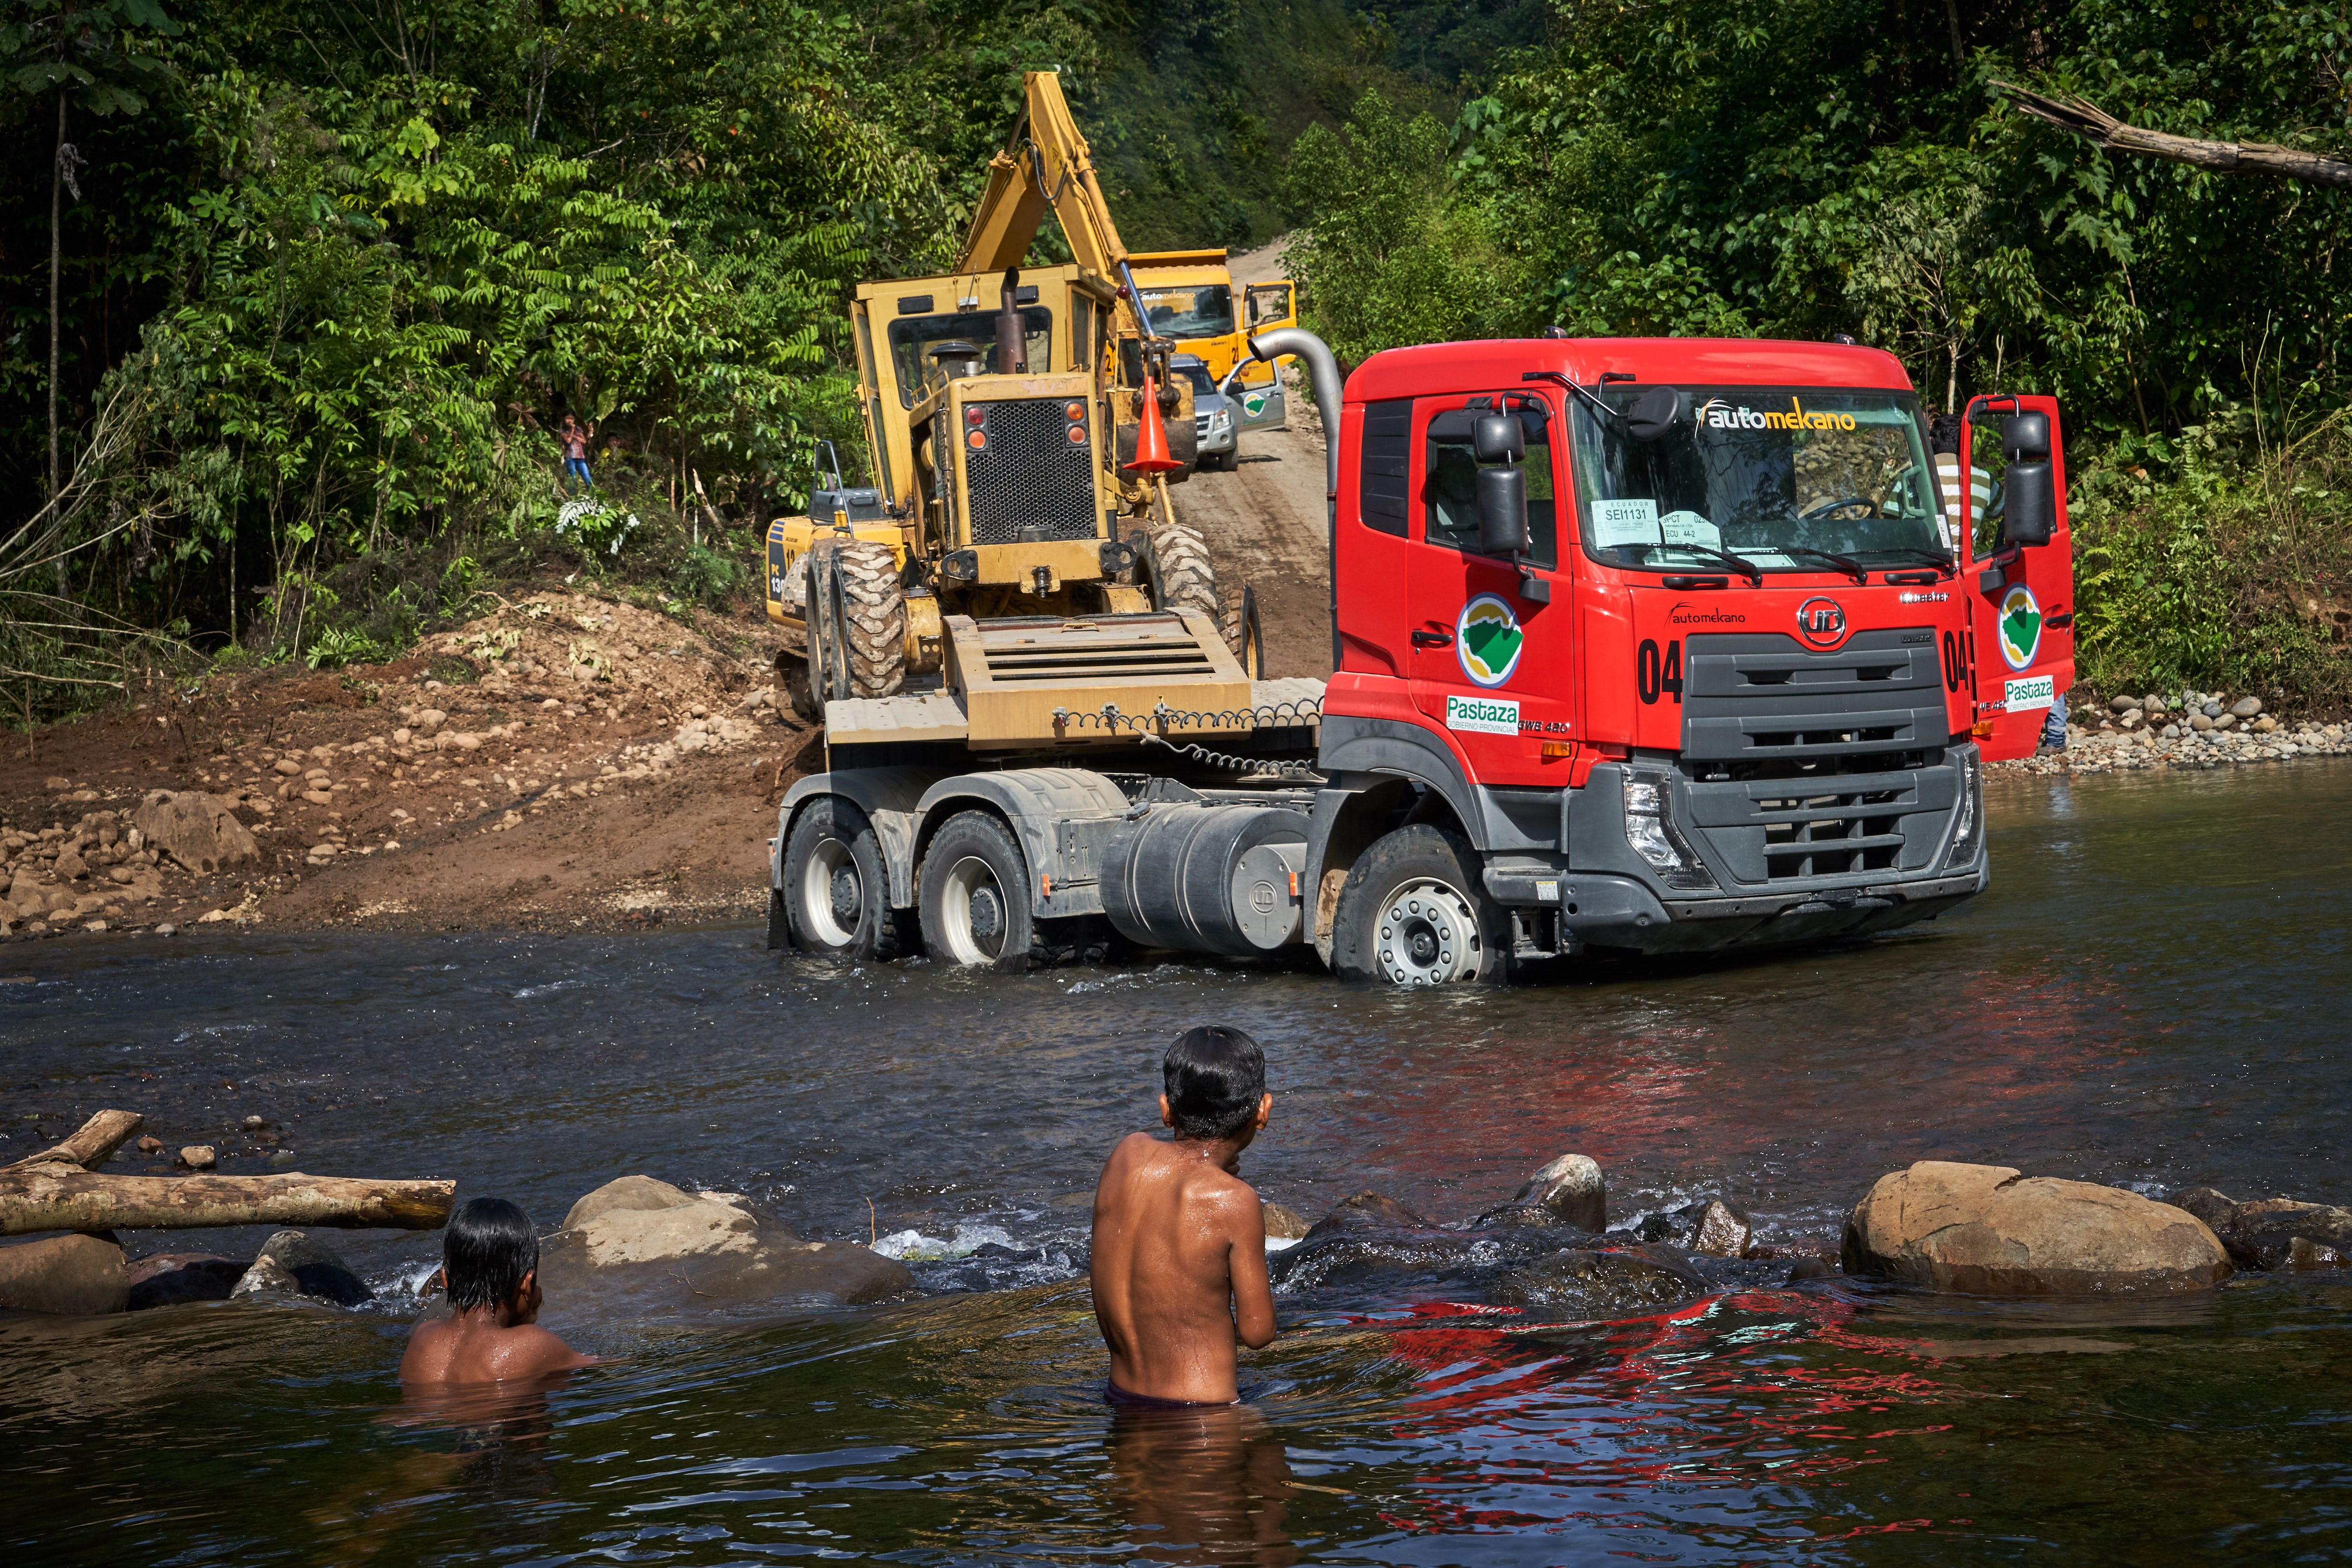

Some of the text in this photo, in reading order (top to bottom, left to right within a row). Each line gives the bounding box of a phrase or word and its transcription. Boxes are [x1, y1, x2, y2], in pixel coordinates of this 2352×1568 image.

[1708, 396, 1856, 430] automekano
[1605, 509, 1647, 520] SEI1131
[1673, 608, 1745, 623] automekano
[1800, 610, 1843, 633] UD
[1944, 630, 1969, 693] 04
[1638, 639, 1683, 705] 04
[2006, 681, 2053, 701] Pastaza
[1447, 697, 1517, 723] Pastaza
[2007, 698, 2054, 712] GOBIERNO PROVINCIAL
[1447, 720, 1517, 734] GOBIERNO PROVINCIAL
[1545, 722, 1570, 733] 420
[1252, 890, 1275, 905] UD
